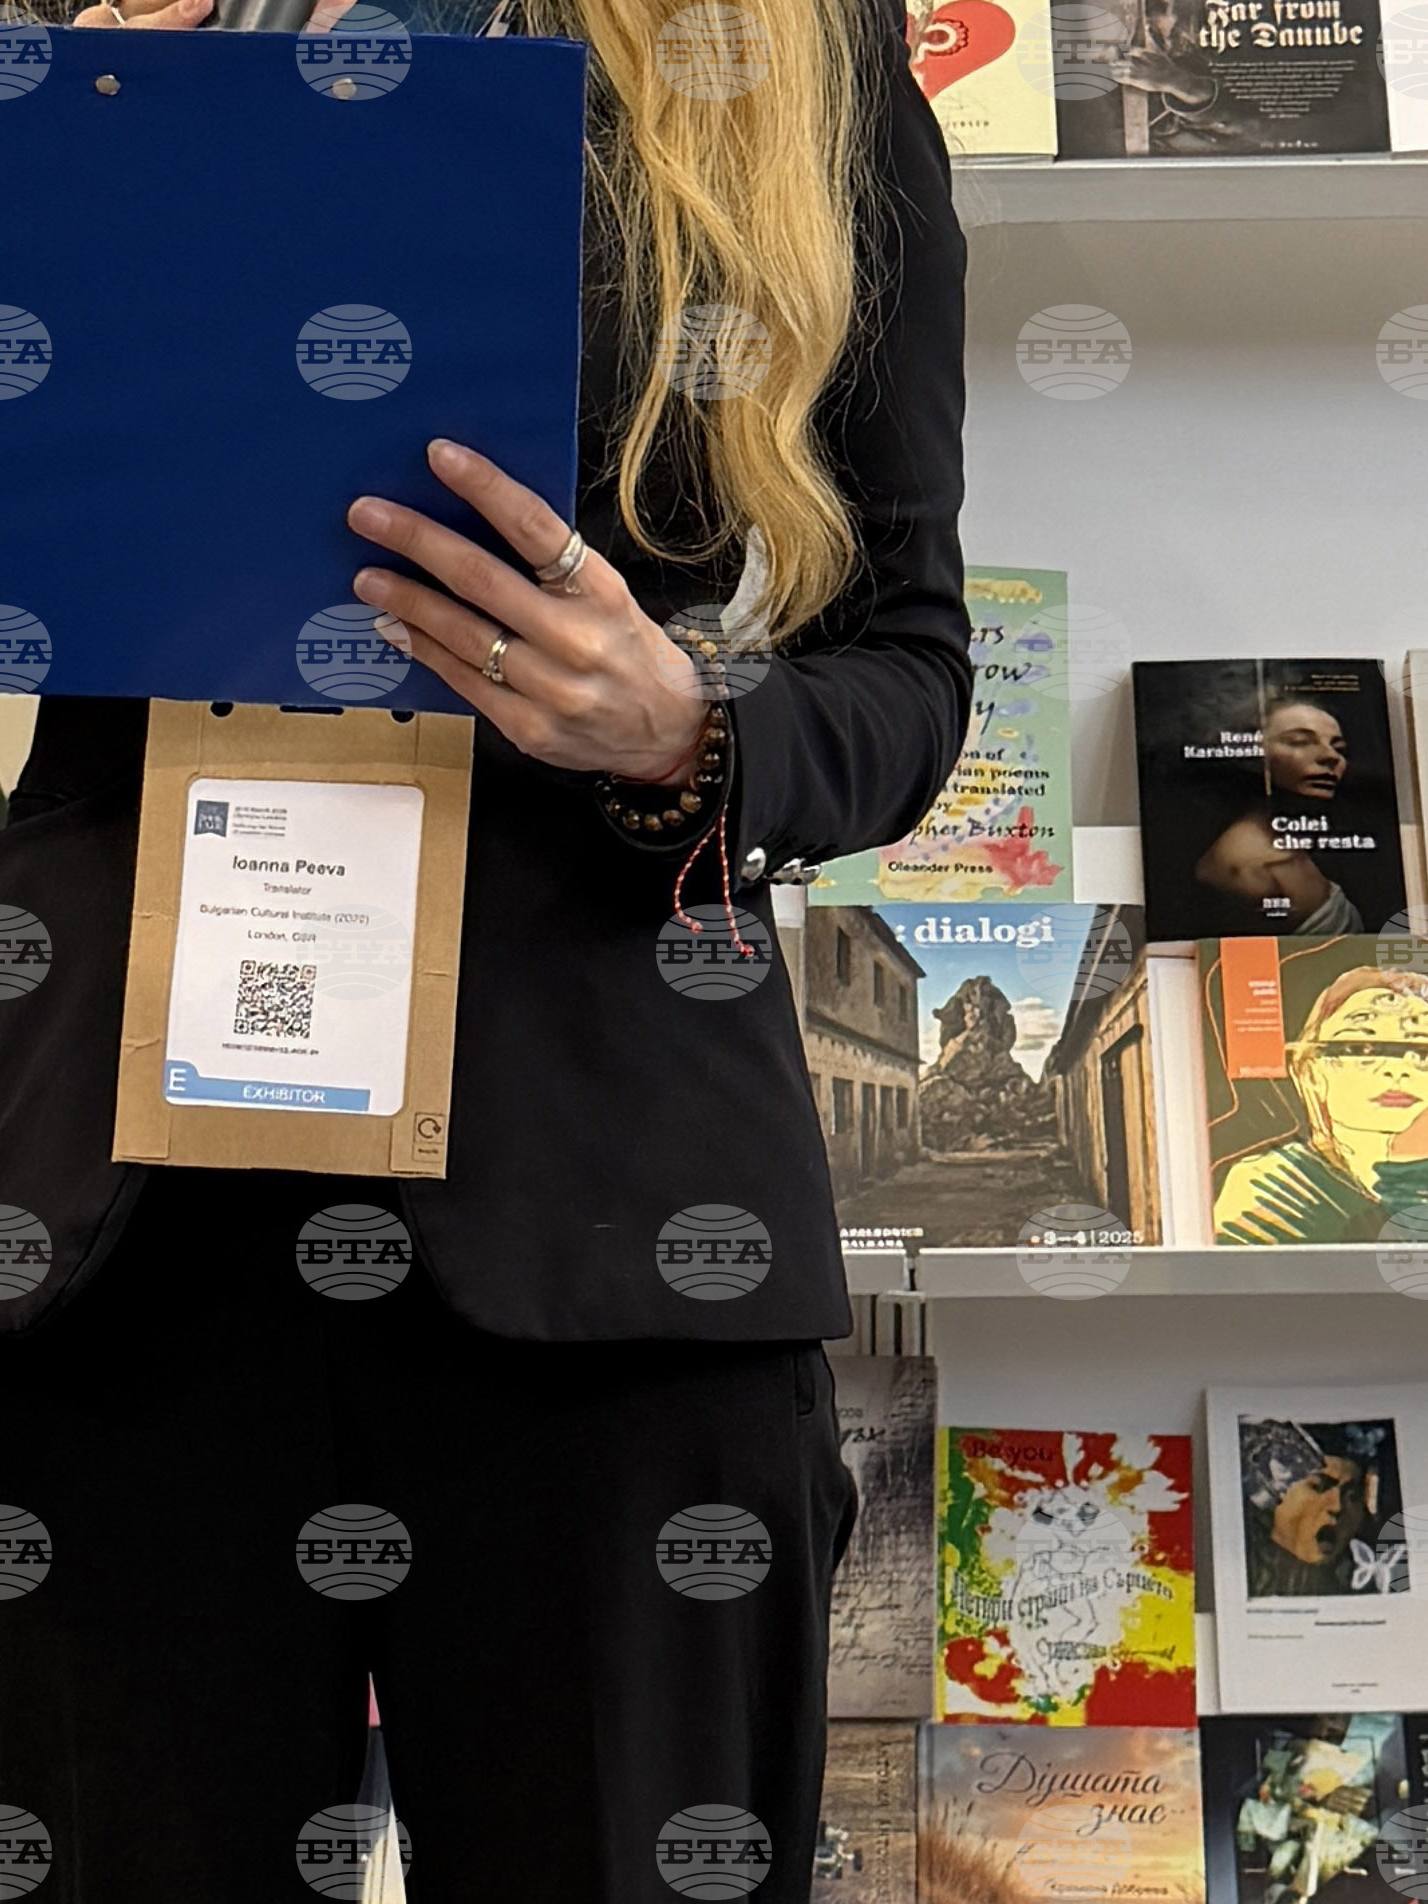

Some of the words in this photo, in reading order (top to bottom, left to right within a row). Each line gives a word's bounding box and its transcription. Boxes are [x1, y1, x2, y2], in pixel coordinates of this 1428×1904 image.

[1199, 22, 1241, 54] the
[1251, 19, 1363, 47] Danube
[1272, 817, 1329, 832] Colei
[1273, 836, 1312, 850] che
[1318, 836, 1376, 850] resta
[232, 856, 290, 873] Ioanna
[295, 860, 346, 877] Peeva
[914, 917, 1055, 948] dialogi
[243, 1085, 326, 1104] EXHIBITOR
